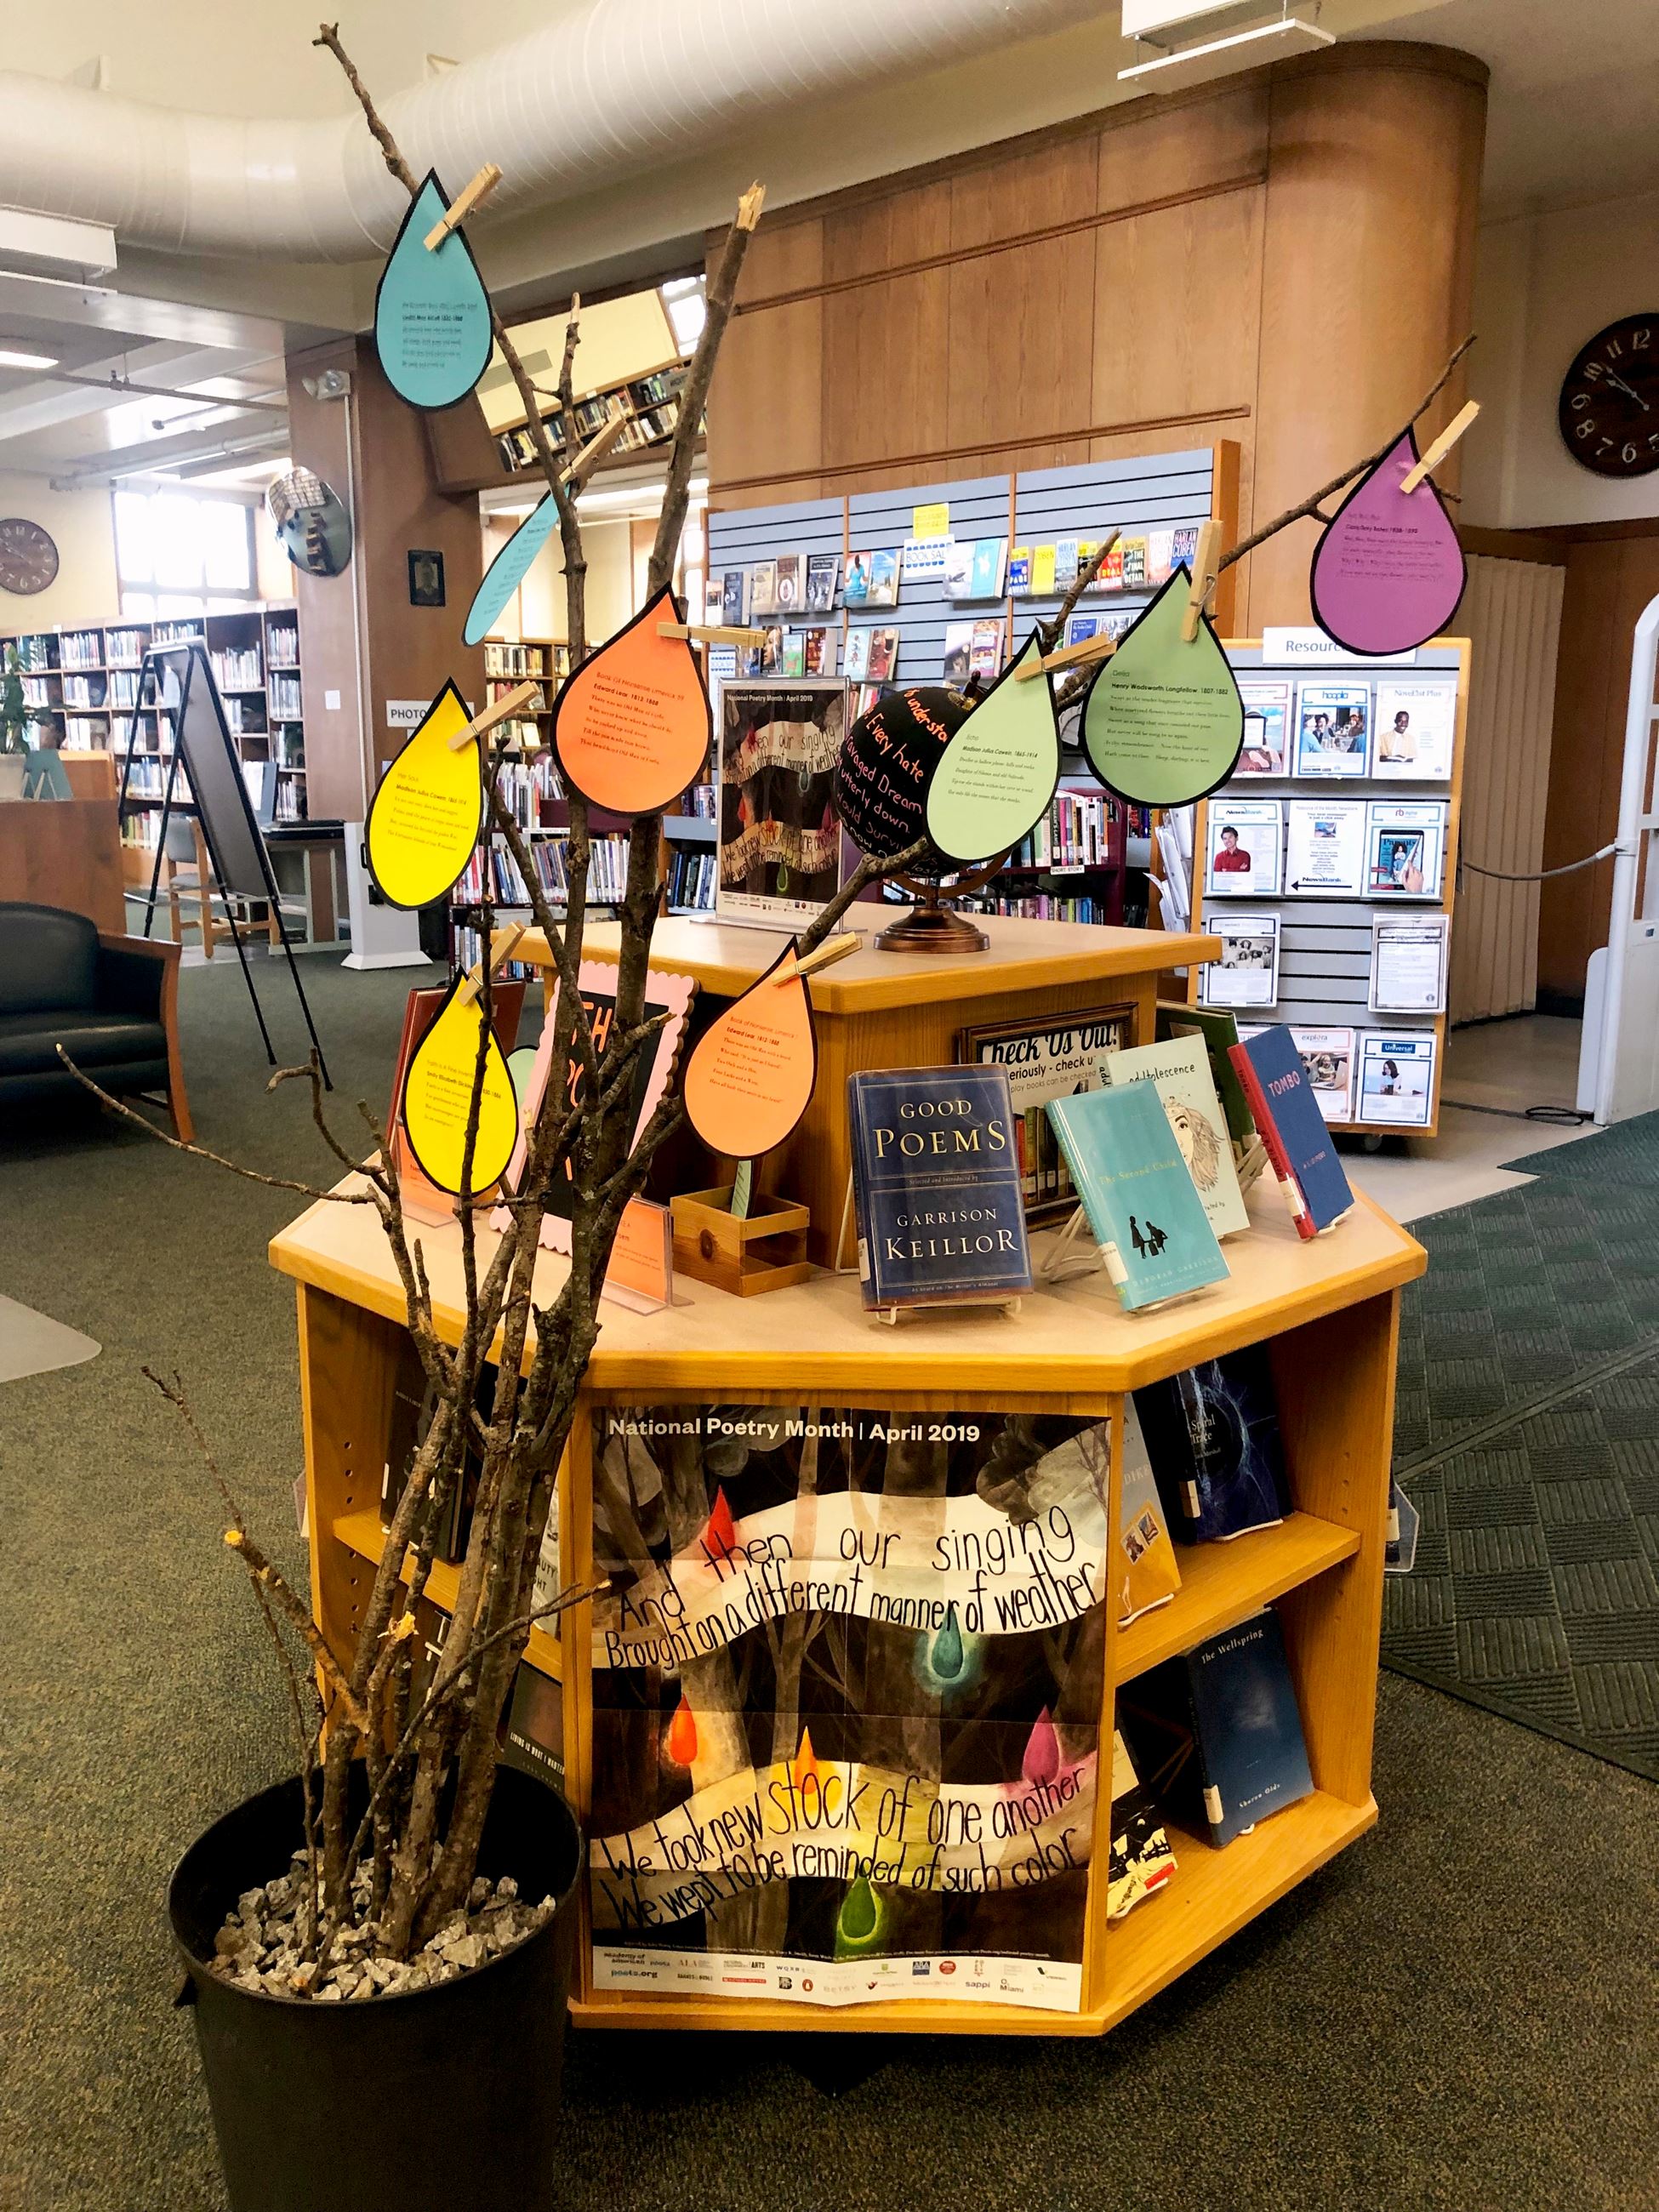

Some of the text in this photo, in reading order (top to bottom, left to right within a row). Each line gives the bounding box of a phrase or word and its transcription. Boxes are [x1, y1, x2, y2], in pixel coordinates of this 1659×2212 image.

[1606, 339, 1622, 359] 11
[1633, 328, 1650, 351] 12
[1583, 362, 1604, 382] 10
[1571, 393, 1592, 410] 9
[1576, 419, 1595, 439] 8
[1595, 436, 1614, 456] 7
[1622, 442, 1637, 463] 6
[1175, 531, 1196, 544] HARLAN
[906, 550, 946, 562] BOOK SAL
[1134, 550, 1143, 559] THE
[1172, 543, 1194, 557] COBEN
[1127, 561, 1143, 571] FINAL
[1124, 573, 1143, 584] DETAIL
[1286, 641, 1343, 653] Resourc
[593, 683, 615, 693] Edward
[615, 689, 628, 698] Lear
[1322, 691, 1349, 701] hoopla
[779, 734, 794, 750] our
[801, 724, 836, 750] singing
[865, 712, 892, 755] Every
[892, 743, 924, 784] hate
[877, 773, 923, 815] Dream
[727, 1027, 745, 1036] Edward
[1046, 1032, 1075, 1058] Us
[1079, 1023, 1118, 1052] Out!
[1301, 1034, 1328, 1042] explora
[1384, 1044, 1413, 1052] Universal
[1009, 1057, 1086, 1081] eriously check
[1129, 1063, 1196, 1085] adltolescence
[1010, 1084, 1026, 1094] play
[1027, 1080, 1046, 1090] books
[1047, 1079, 1059, 1087] can
[1060, 1075, 1069, 1084] be
[1070, 1070, 1097, 1082] checked
[1268, 1070, 1301, 1097] TOMBO
[900, 1099, 972, 1120] GOOD
[873, 1120, 1007, 1159] POEMS
[1100, 1176, 1116, 1185] The
[1119, 1166, 1150, 1181] Second
[897, 1208, 998, 1228] GARRISON
[884, 1229, 1020, 1261] KEILLOR
[609, 1418, 980, 1444] National Poetry Month April 2019
[620, 1505, 1076, 1632] And then our singing
[605, 1549, 1096, 1670] Brought on a different manner of weather
[1201, 1629, 1264, 1665] The Wellspring
[510, 1731, 525, 1747] LIVING
[531, 1746, 544, 1760] WHAT
[547, 1757, 566, 1776] WANTED
[1264, 1783, 1281, 1795] Olds
[600, 1761, 1086, 1880] We took new stock of one another
[599, 1827, 1077, 1930] We wept to be reminded of such color
[611, 1969, 658, 1979] poets.org
[751, 1960, 766, 1970] ARTS
[965, 1981, 990, 1990] sappi
